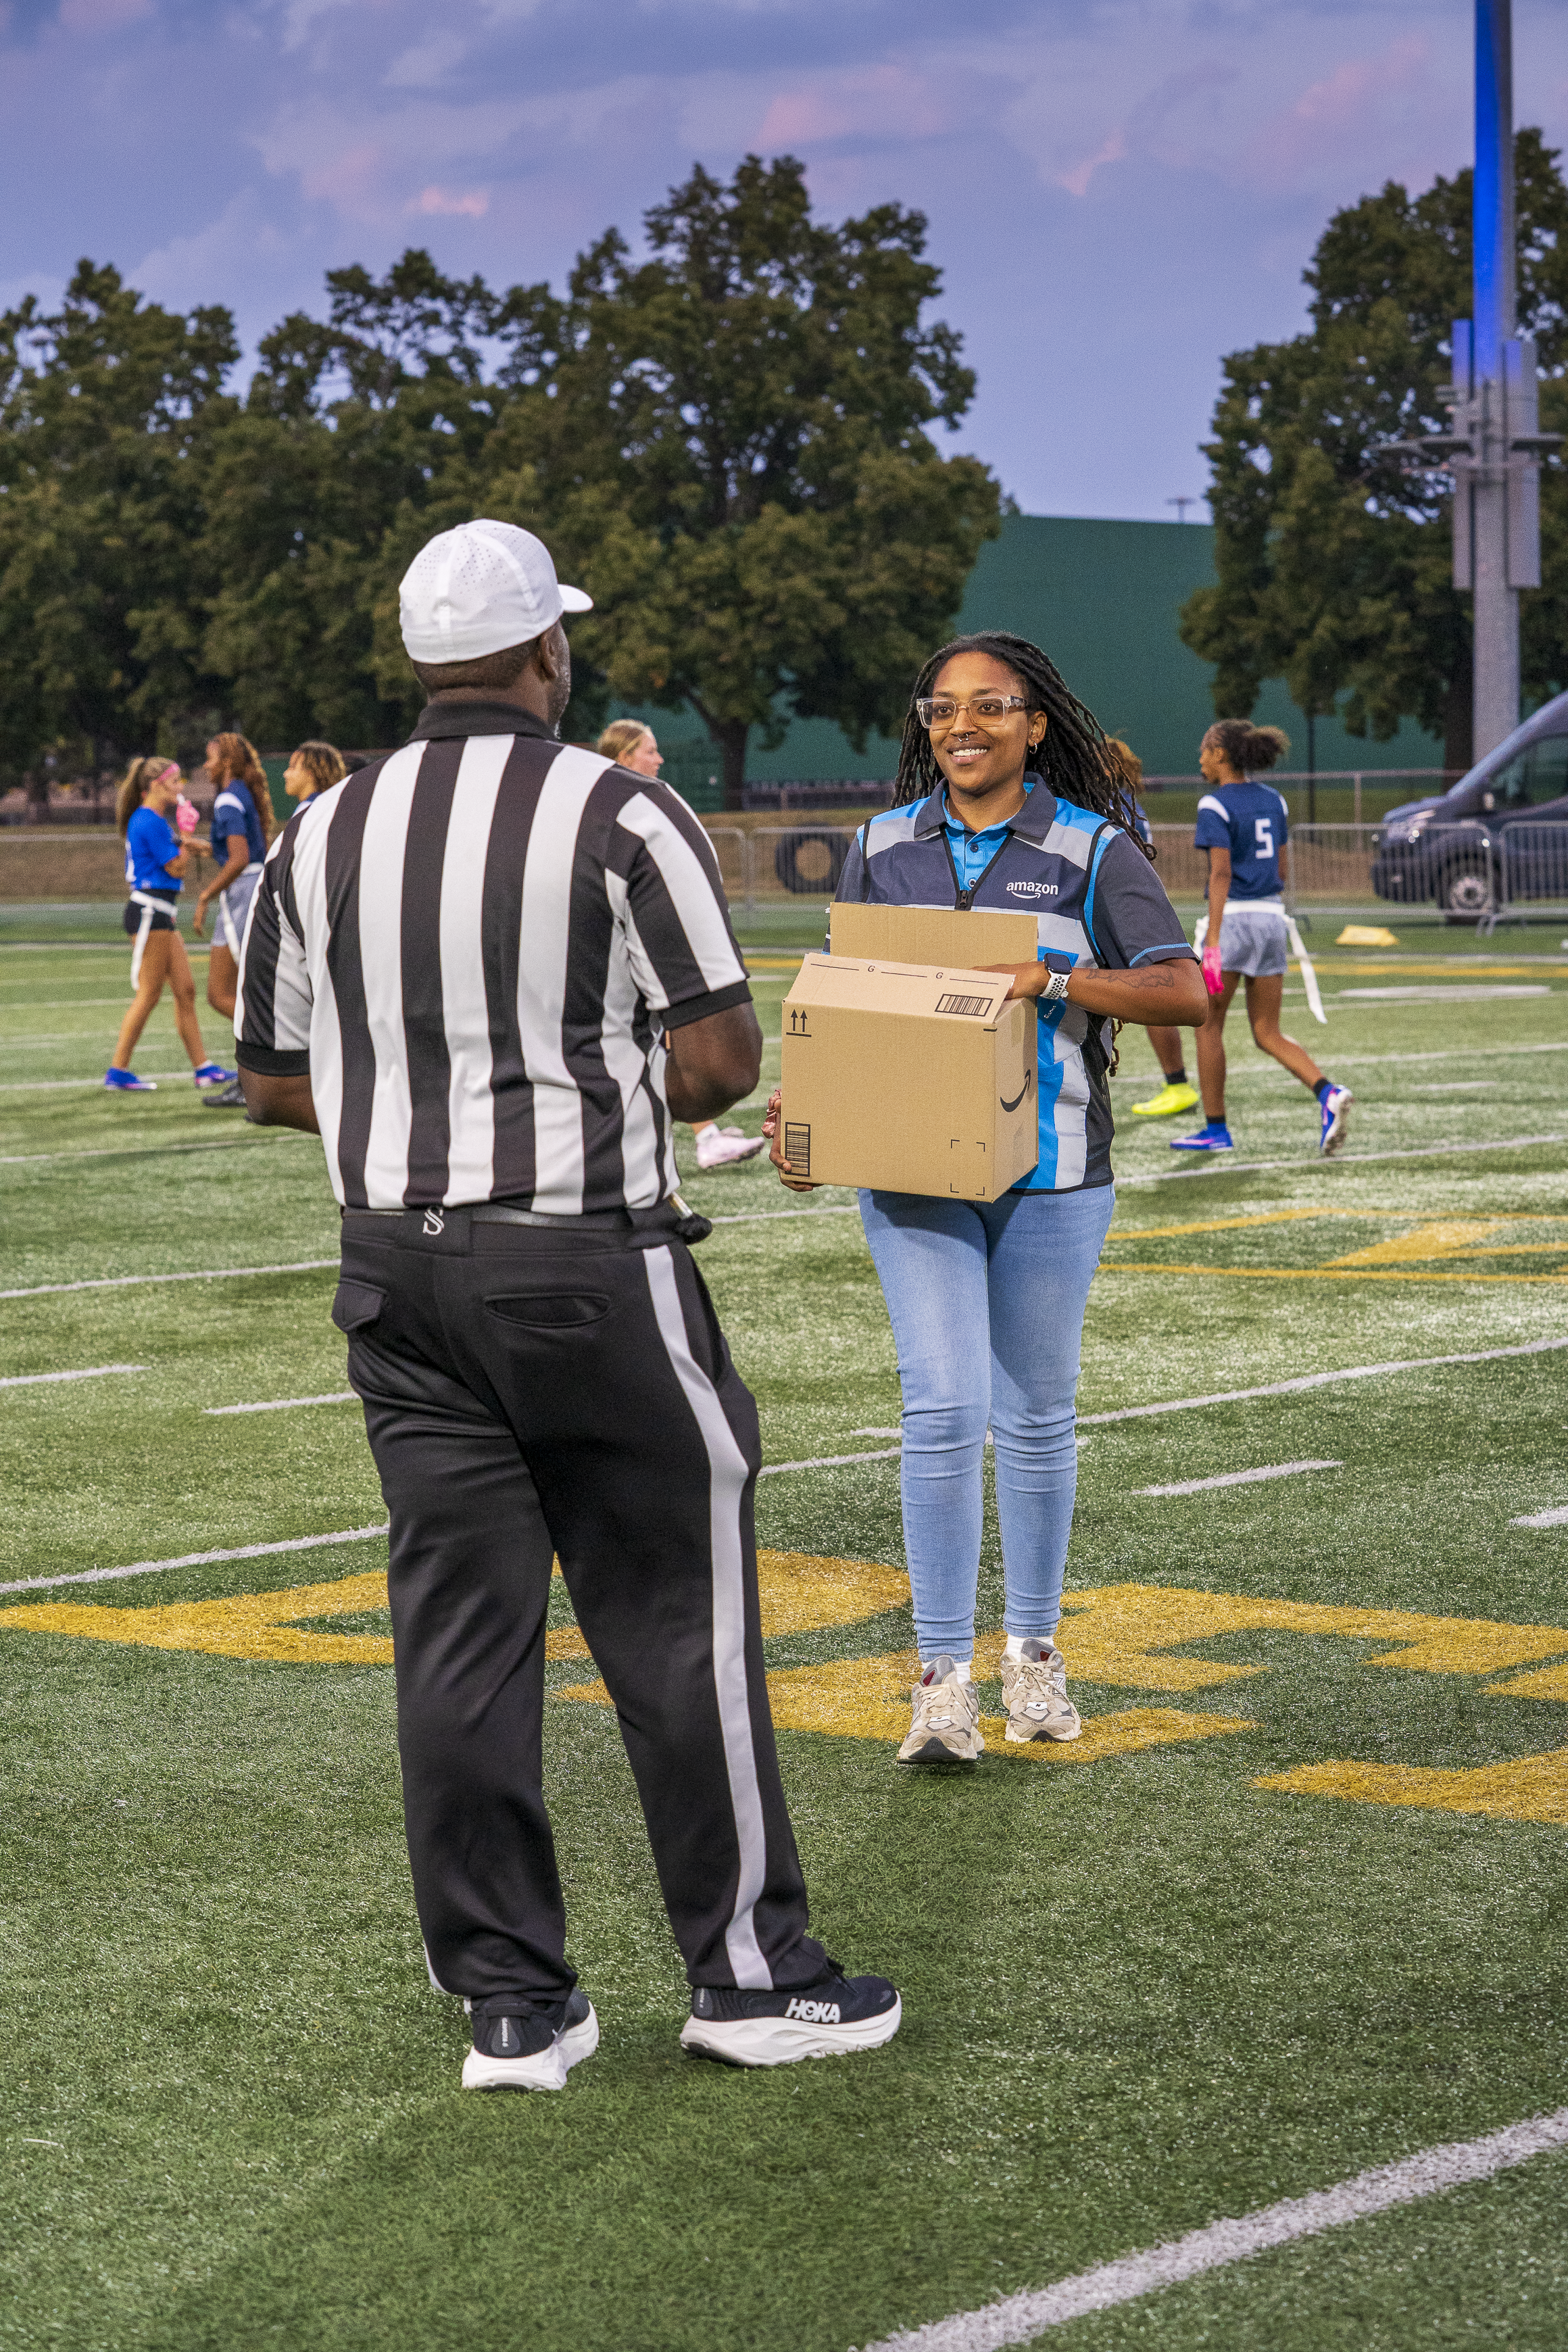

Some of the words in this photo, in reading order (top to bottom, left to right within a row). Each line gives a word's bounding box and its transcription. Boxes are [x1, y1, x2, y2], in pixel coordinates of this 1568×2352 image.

[1255, 818, 1274, 859] 5
[1006, 881, 1059, 896] amazon
[784, 1998, 841, 2024] HOKA
